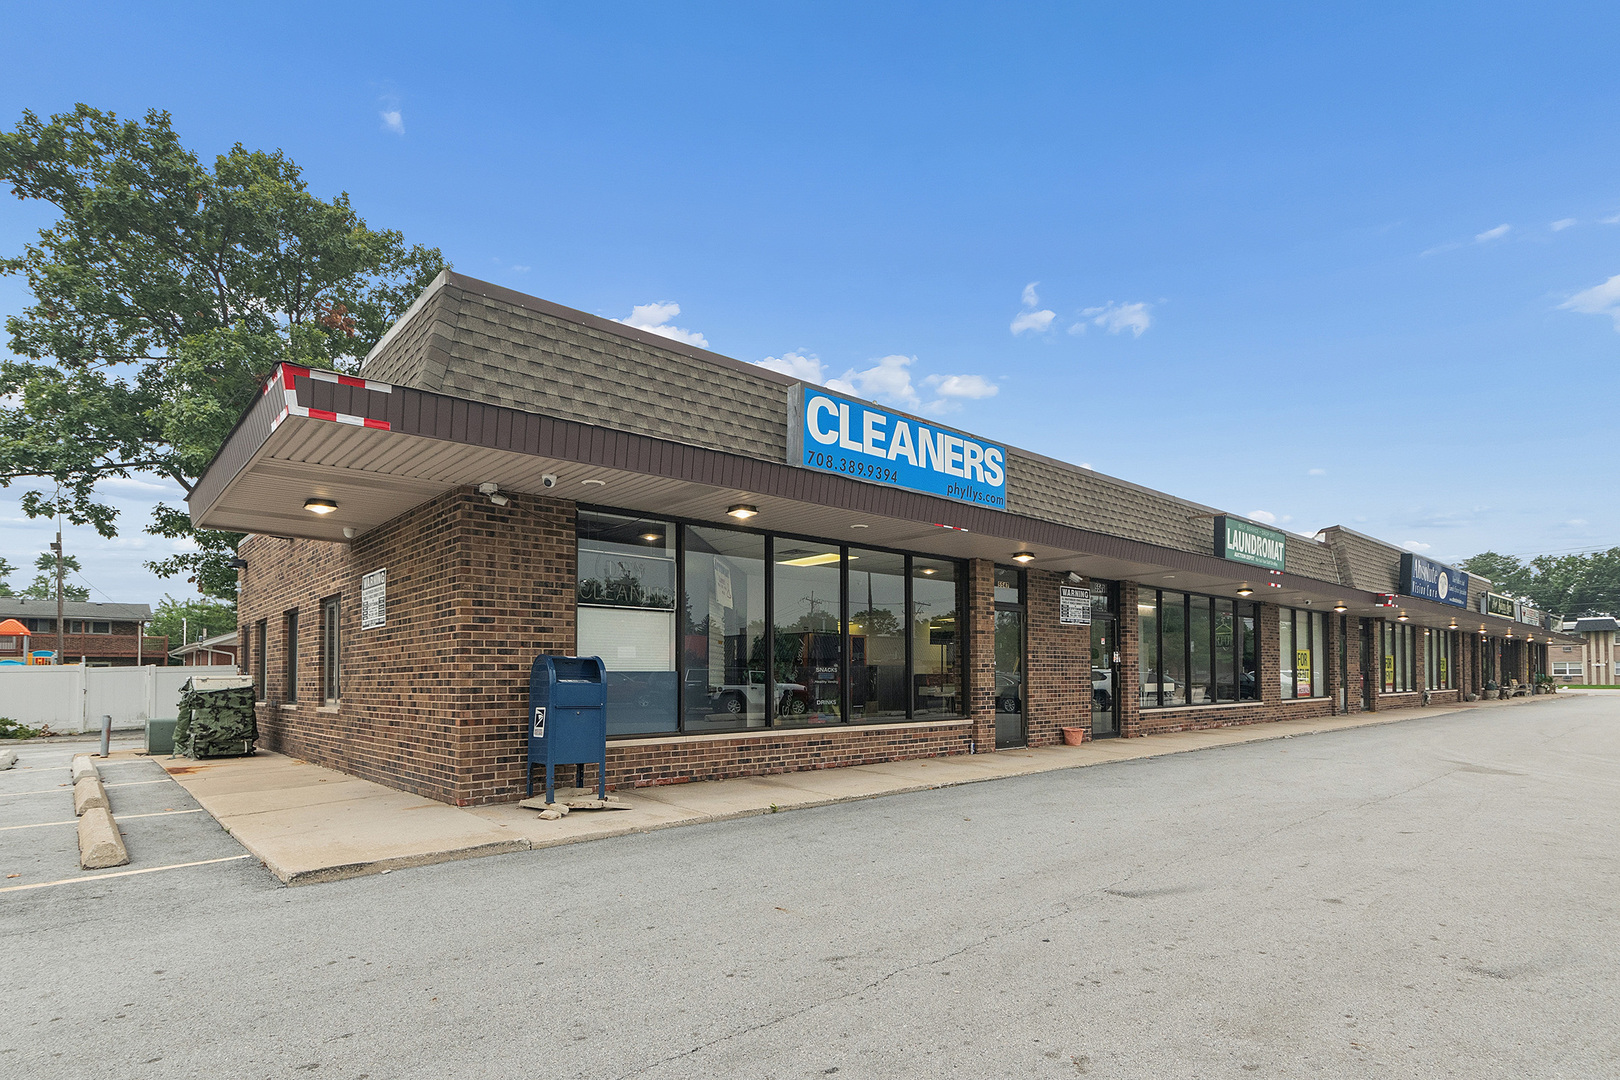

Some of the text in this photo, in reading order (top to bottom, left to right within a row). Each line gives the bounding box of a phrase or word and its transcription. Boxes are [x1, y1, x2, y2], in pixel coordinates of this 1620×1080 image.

[807, 396, 1004, 487] CLEANERS
[807, 450, 898, 483] 708.389.9394
[946, 482, 1004, 506] phyllys.com
[1227, 527, 1284, 562] LAUNDROMAT
[1062, 588, 1089, 599] WARNING
[1297, 652, 1308, 666] FOR
